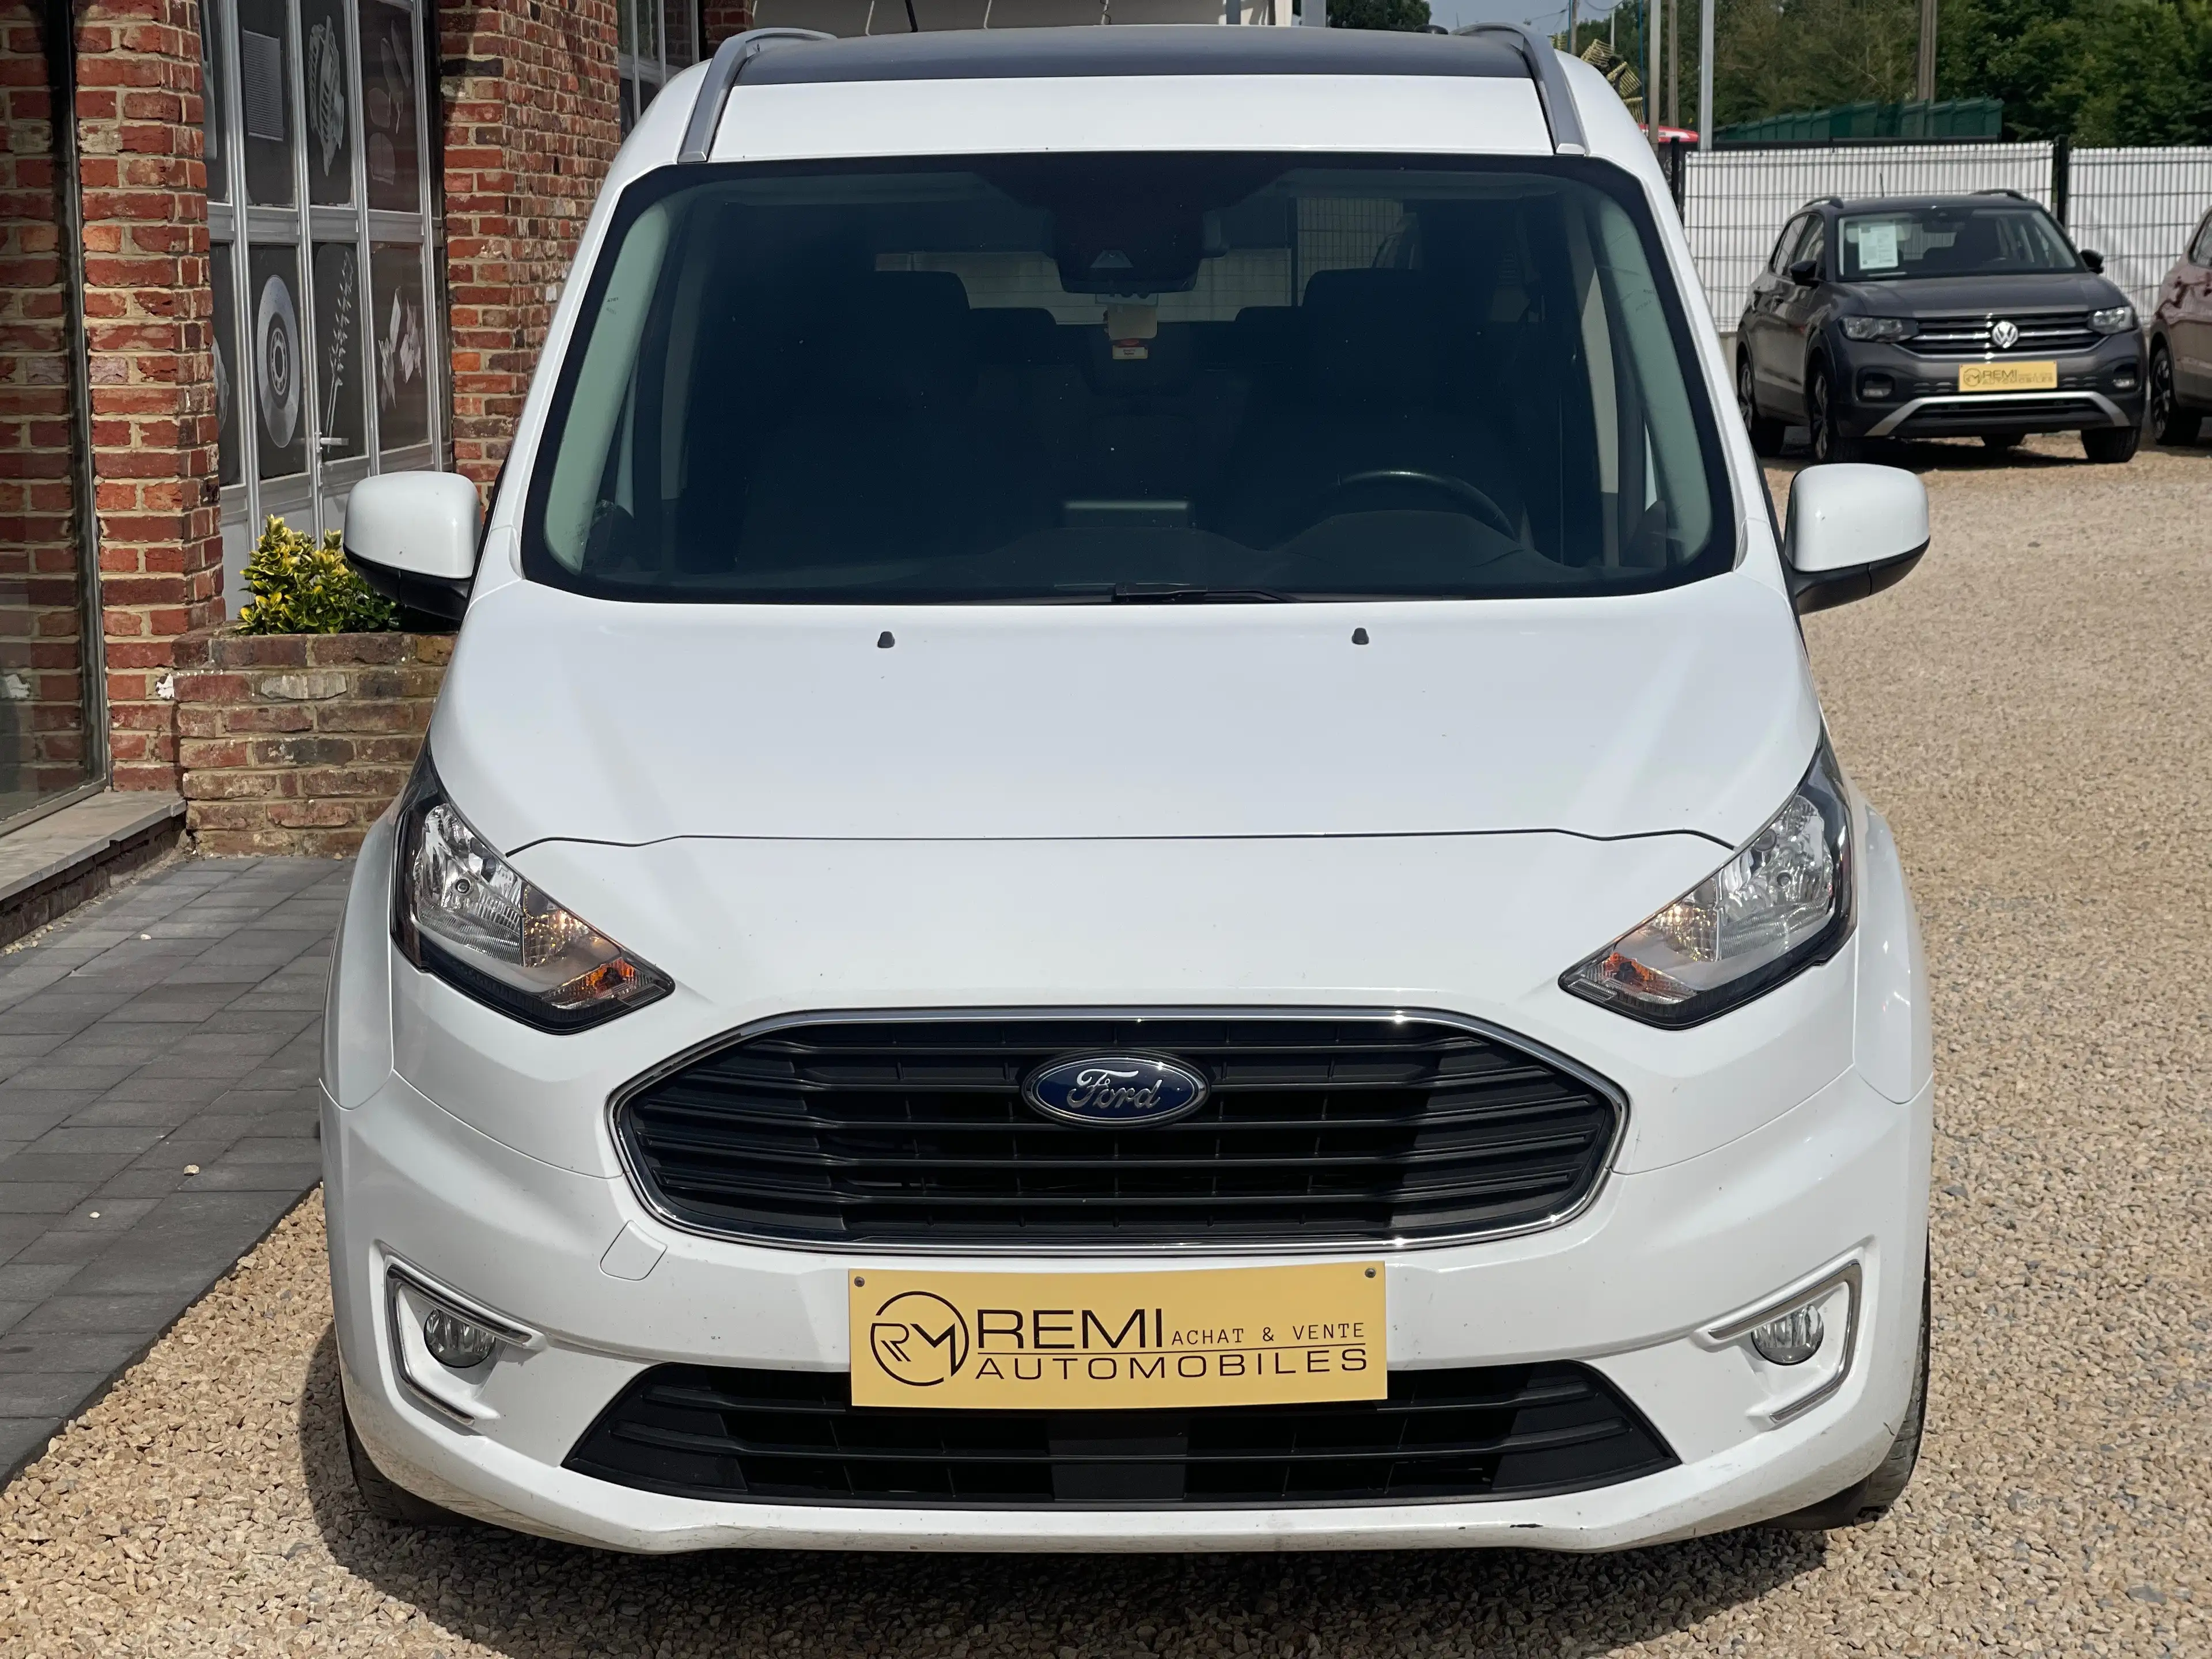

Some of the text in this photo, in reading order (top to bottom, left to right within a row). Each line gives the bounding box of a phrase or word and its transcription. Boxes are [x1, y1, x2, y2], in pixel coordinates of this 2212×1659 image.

[1983, 369, 2017, 380] REMI
[1066, 1068, 1162, 1109] Ford
[977, 1308, 1365, 1349] REMI ACHAT & VENTE
[975, 1349, 1368, 1380] AUTOMOBILES
